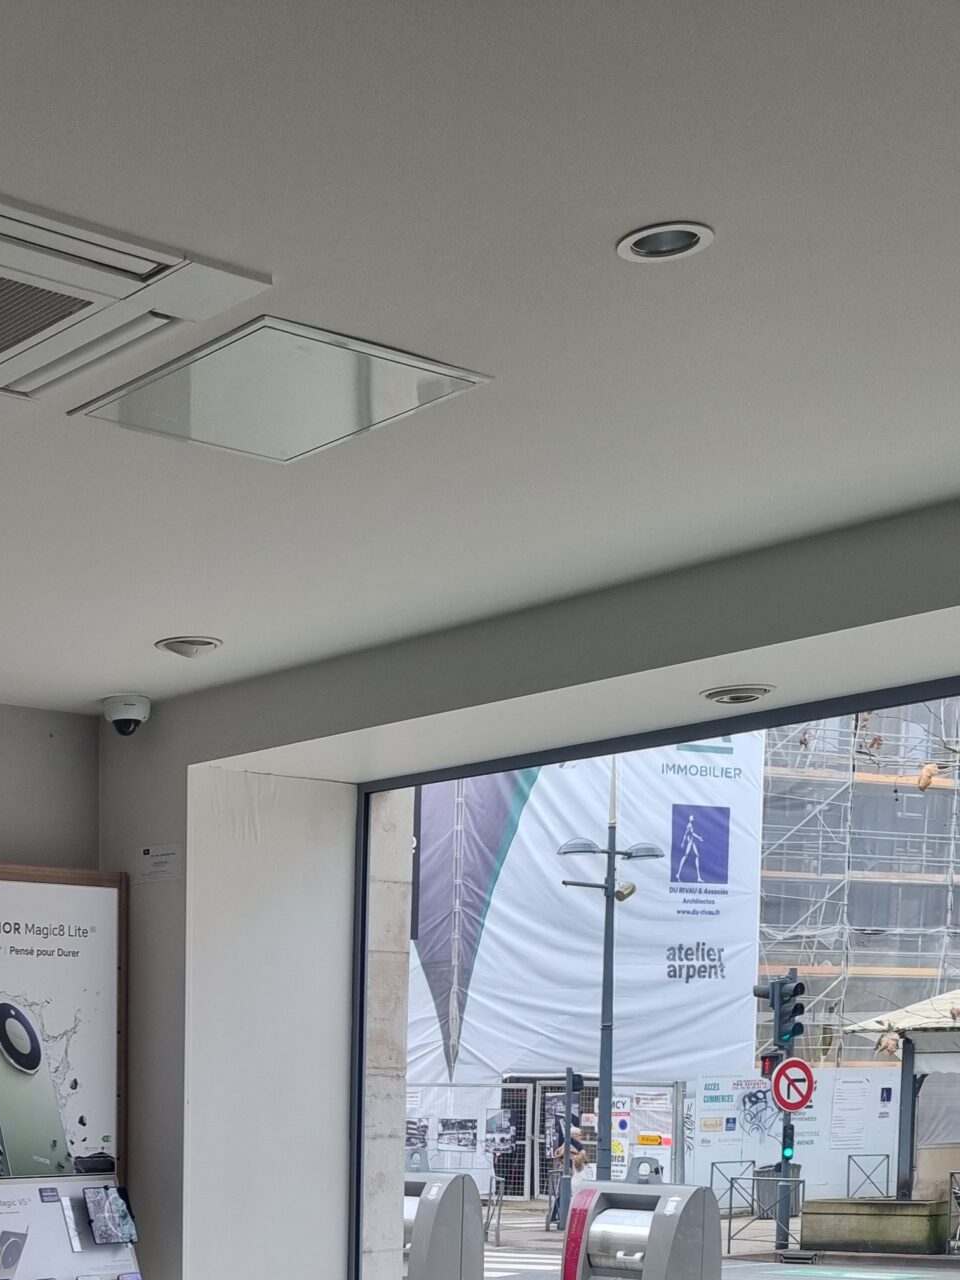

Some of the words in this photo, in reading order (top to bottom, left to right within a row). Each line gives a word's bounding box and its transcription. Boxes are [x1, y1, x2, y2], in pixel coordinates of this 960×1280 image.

[661, 763, 742, 779] IMMOBILIER
[24, 923, 64, 938] Magic8
[68, 925, 89, 937] Lite
[10, 946, 34, 956] Pensé
[36, 949, 55, 958] pour
[57, 948, 79, 957] Durer
[666, 942, 724, 962] atelier
[667, 962, 726, 984] arpent
[703, 1094, 734, 1103] COMMERCES
